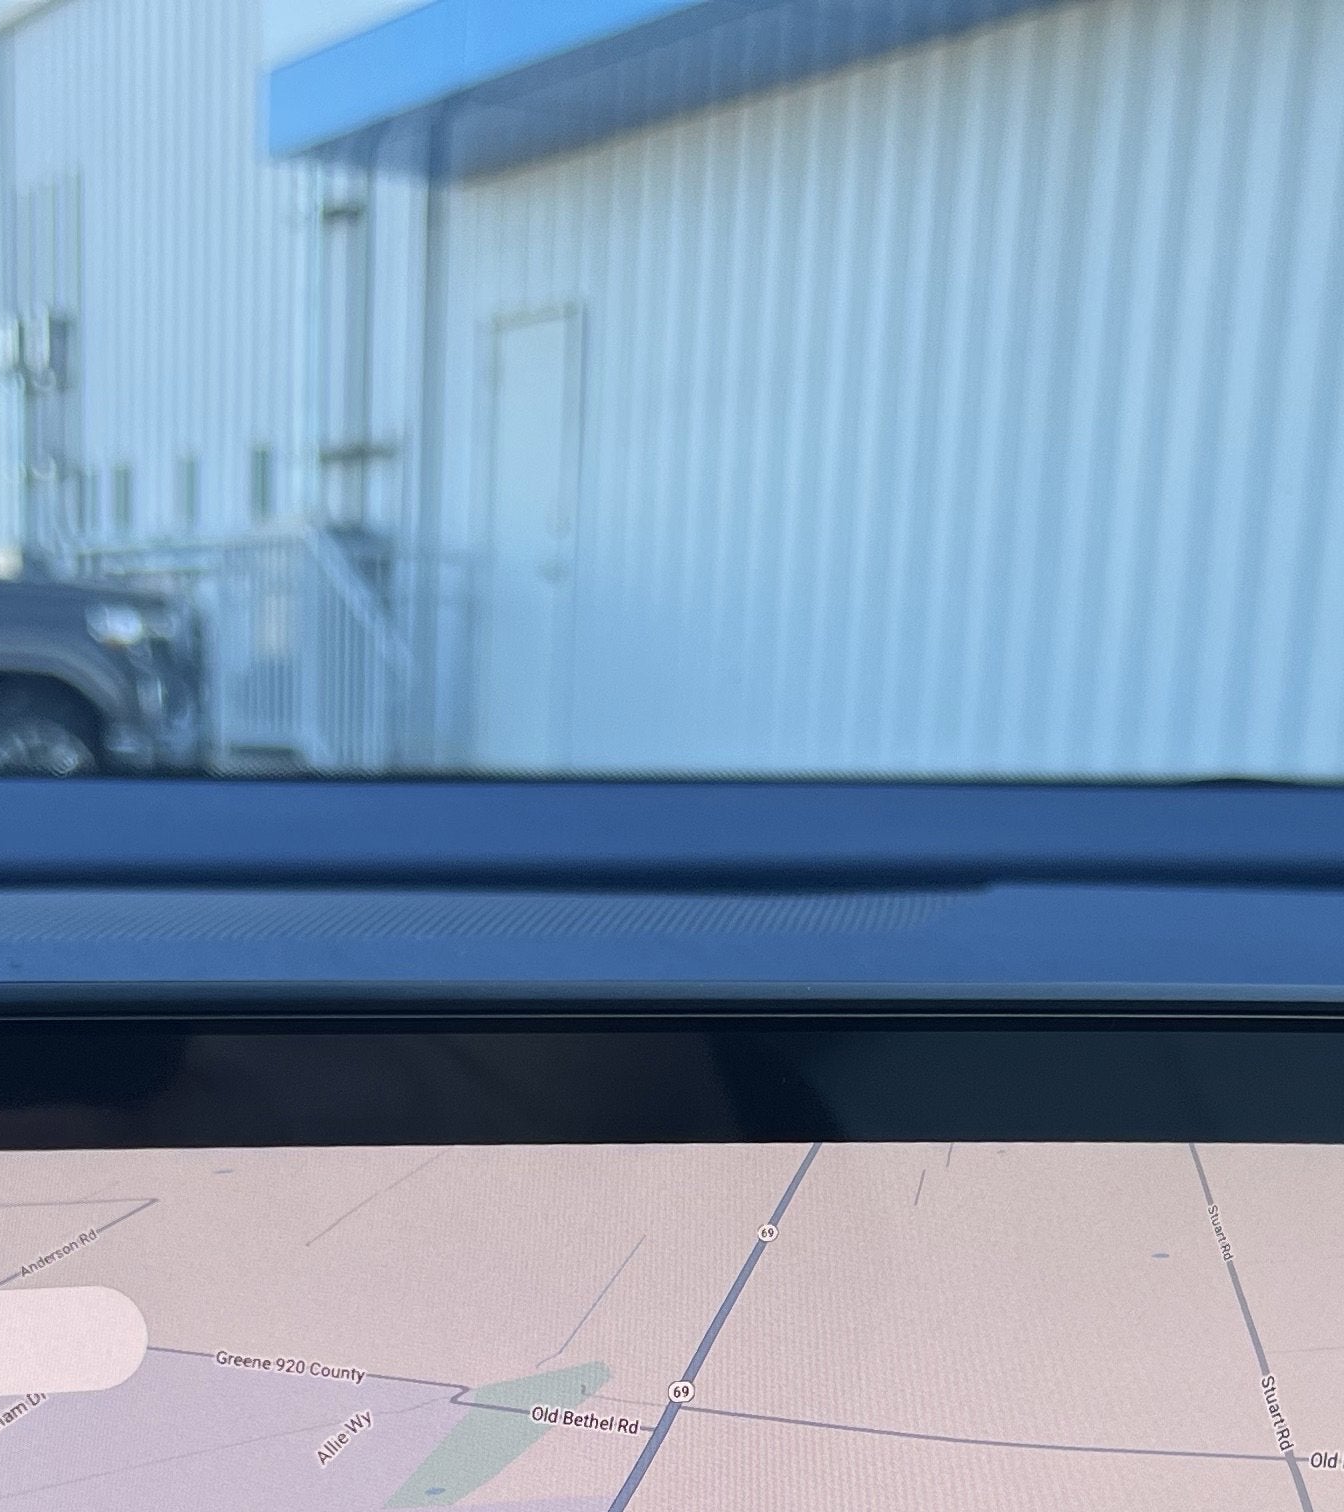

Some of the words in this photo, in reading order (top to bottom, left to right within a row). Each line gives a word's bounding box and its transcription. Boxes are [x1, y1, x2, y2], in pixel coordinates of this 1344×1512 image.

[761, 1227, 775, 1239] 69
[1208, 1204, 1226, 1243] Stuart
[1222, 1243, 1234, 1262] Rd
[21, 1241, 78, 1277] Anderson
[78, 1228, 97, 1246] Rd
[215, 1350, 272, 1372] Greene
[275, 1358, 306, 1375] 920
[309, 1361, 366, 1384] County
[673, 1384, 690, 1399] 69
[531, 1405, 558, 1425] Old
[562, 1408, 612, 1431] Bethel
[616, 1417, 639, 1436] Rd
[1261, 1375, 1284, 1427] Stuart
[1276, 1427, 1294, 1451] Rd
[316, 1432, 350, 1465] Allie
[344, 1411, 372, 1433] Wy
[1309, 1452, 1339, 1471] Old
